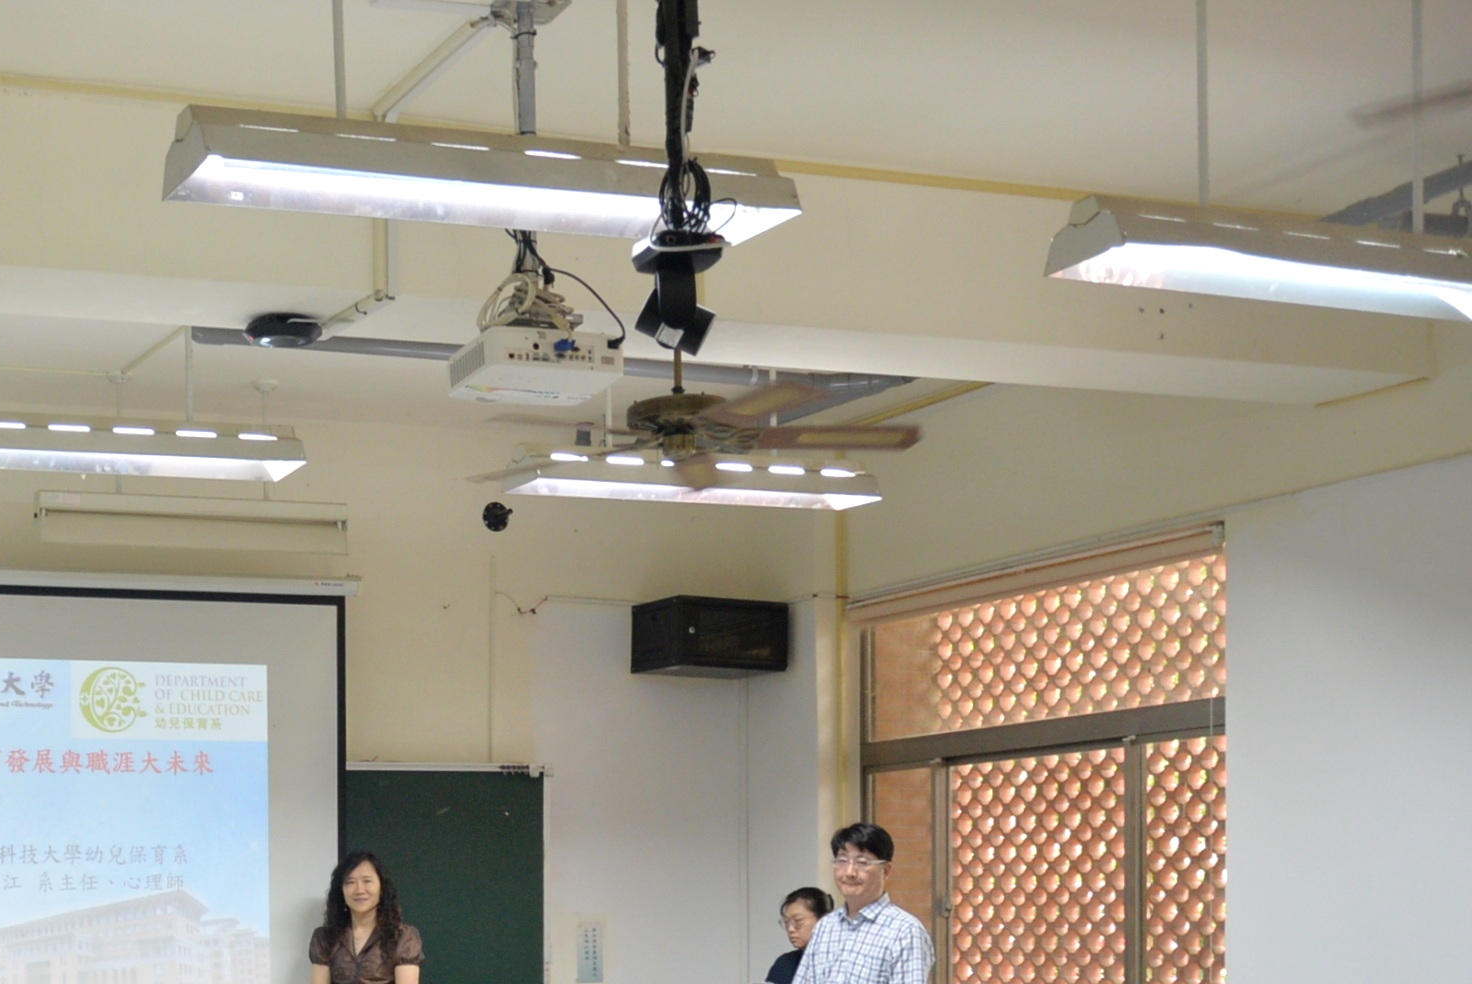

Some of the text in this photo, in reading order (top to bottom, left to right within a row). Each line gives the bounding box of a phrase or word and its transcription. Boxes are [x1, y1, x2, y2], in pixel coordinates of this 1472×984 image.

[154, 674, 247, 688] DEPARTMENT
[154, 688, 263, 702] OF CHILD CARE
[10, 700, 54, 709] Technology
[154, 703, 250, 716] & EDUCATION
[154, 716, 223, 730] 幼兒保育系
